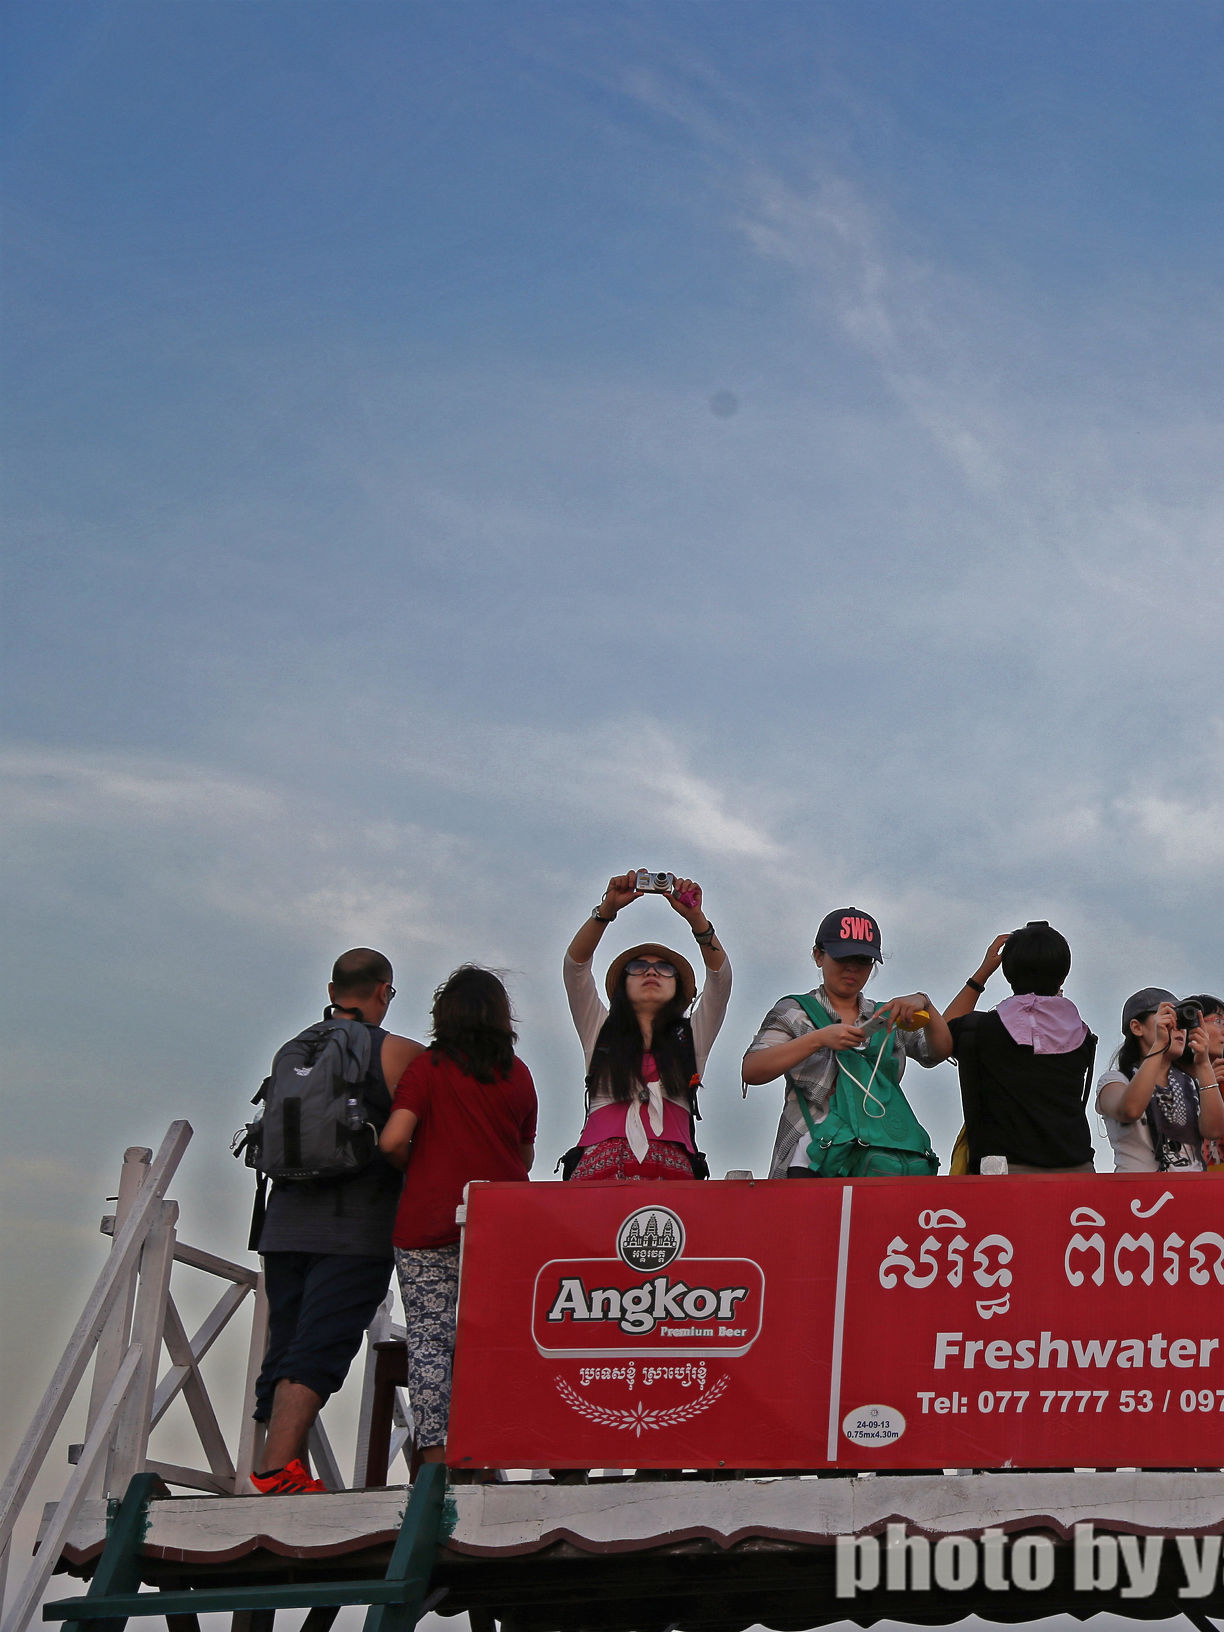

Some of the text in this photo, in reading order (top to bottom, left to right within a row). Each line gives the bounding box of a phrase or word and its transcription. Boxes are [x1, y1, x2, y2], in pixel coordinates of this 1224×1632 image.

[840, 916, 874, 942] SWC
[548, 1276, 749, 1335] Angkor
[660, 1326, 747, 1337] Premium Beer
[933, 1331, 1220, 1370] Freshwater
[917, 1392, 968, 1415] Tel:
[977, 1391, 1030, 1414] 077
[1039, 1391, 1110, 1413] 7777
[1118, 1390, 1154, 1413] 53
[857, 1421, 890, 1429] 24-09-13
